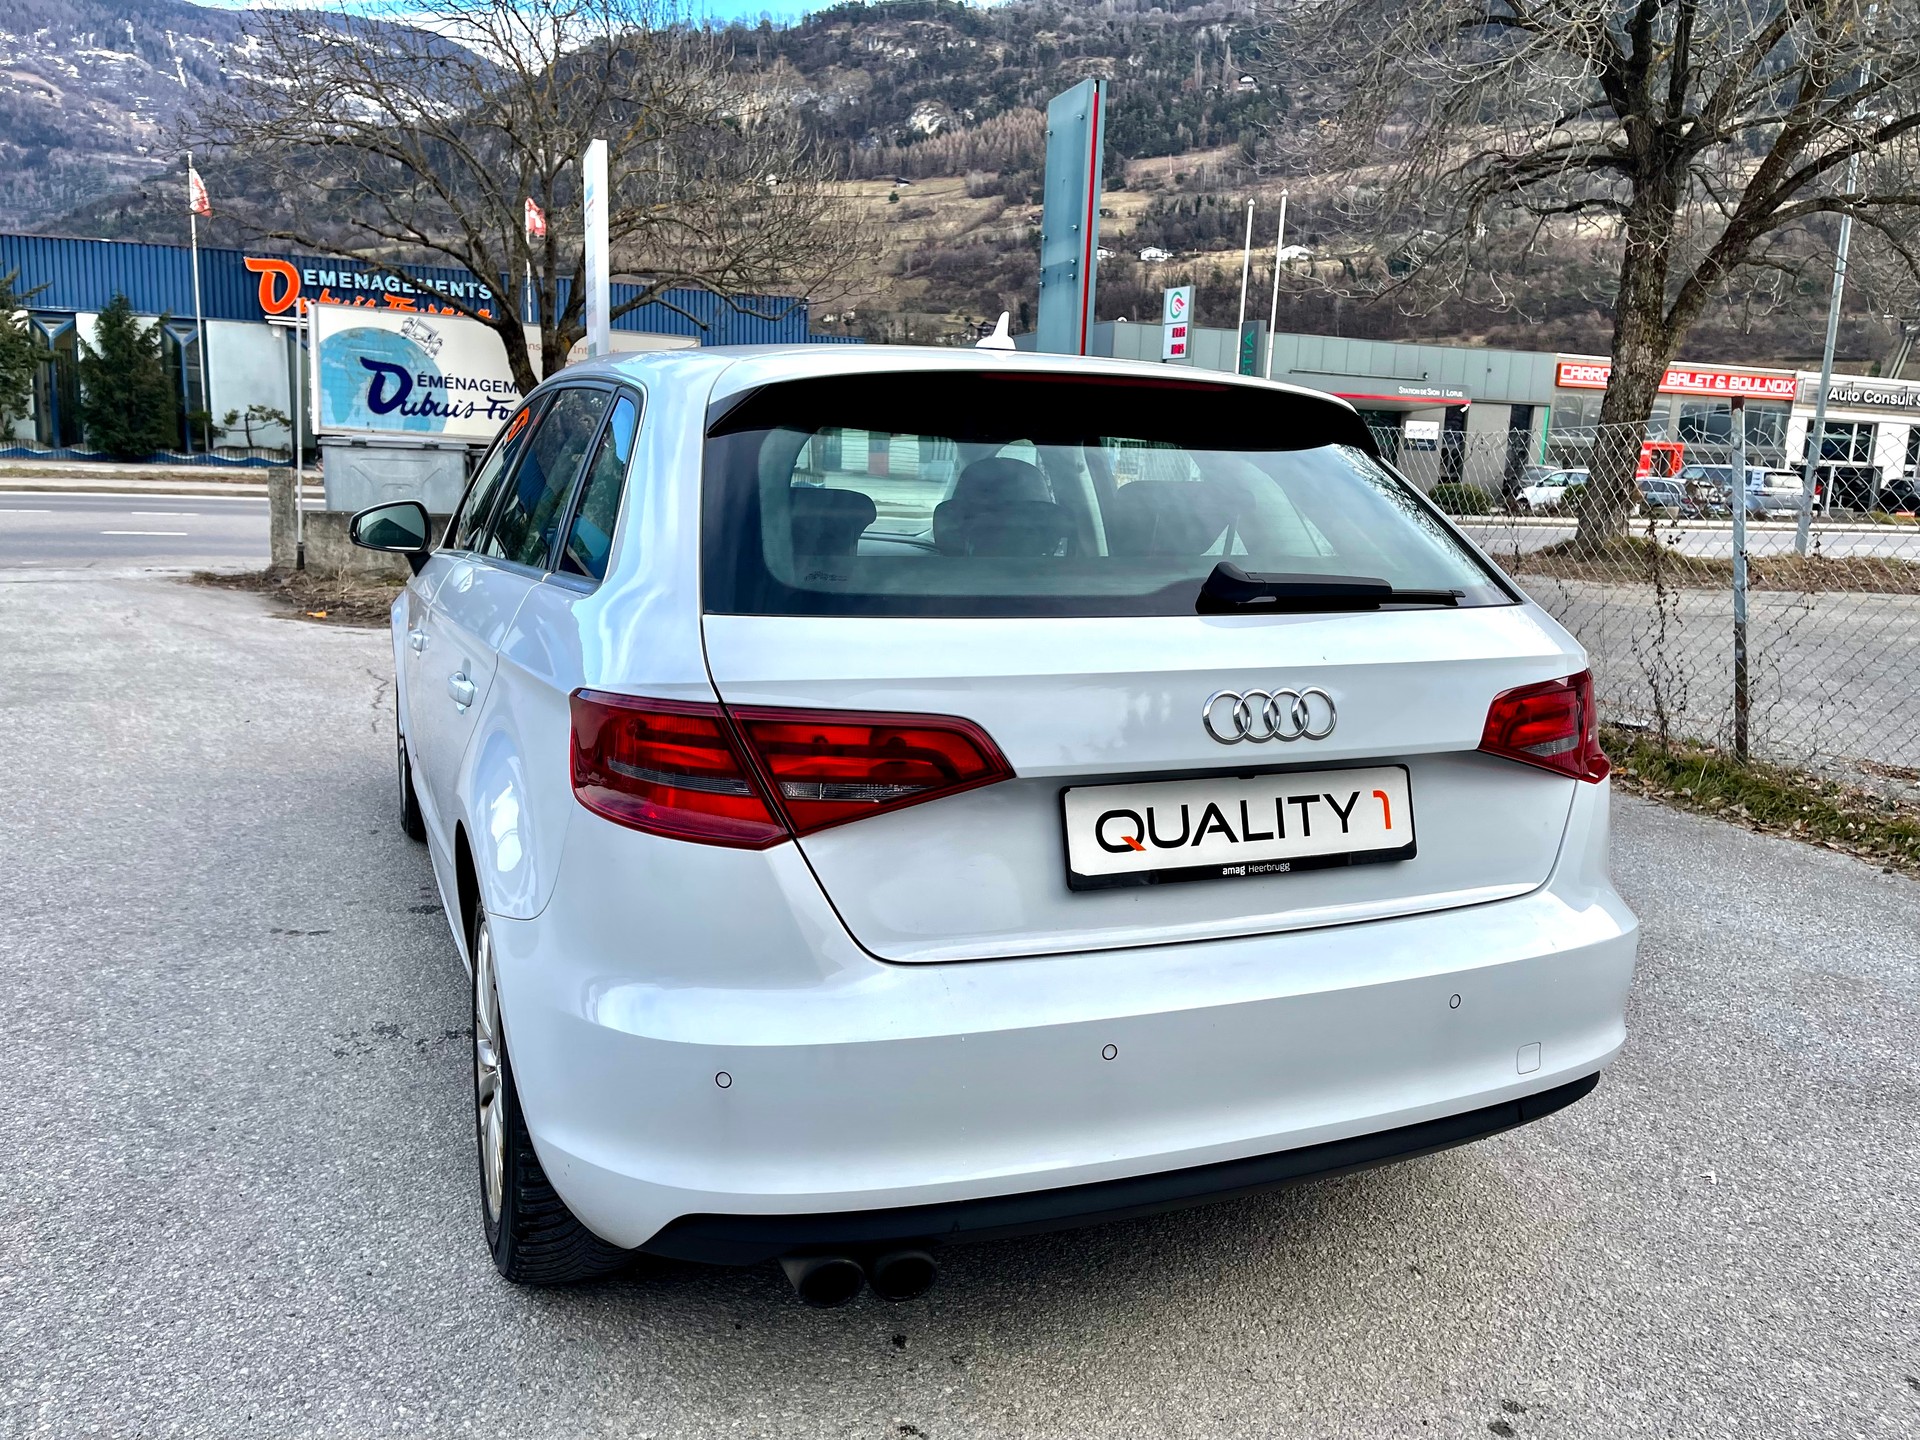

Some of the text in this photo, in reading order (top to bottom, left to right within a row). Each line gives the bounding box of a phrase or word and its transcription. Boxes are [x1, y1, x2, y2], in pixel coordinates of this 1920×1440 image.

[1667, 371, 1714, 389] BALET
[1715, 376, 1727, 390] &
[1729, 376, 1796, 394] BOULNOIX
[1828, 387, 1860, 402] Auto
[1863, 390, 1913, 406] Consult
[1095, 791, 1361, 854] QUALITY
[1222, 862, 1291, 876] amag Heerbrugg
